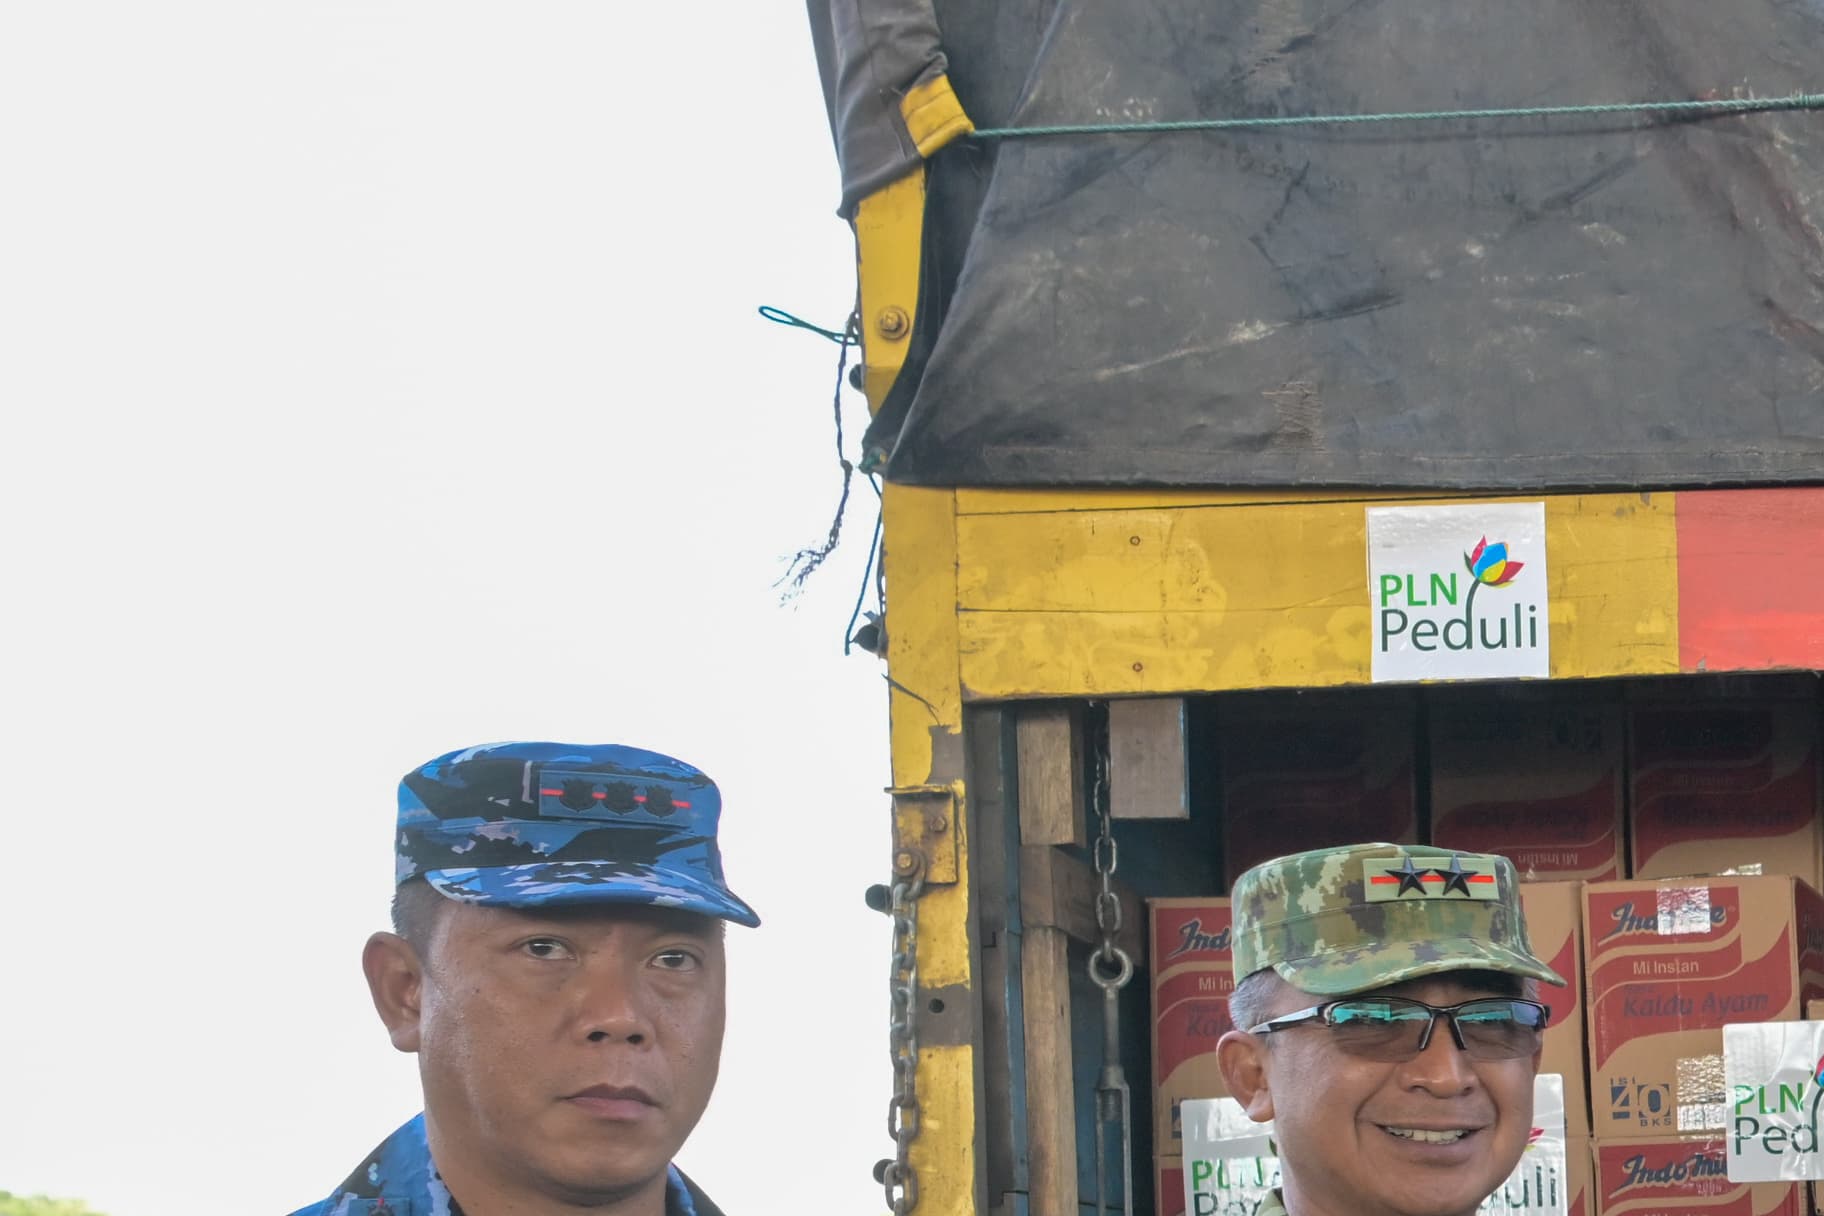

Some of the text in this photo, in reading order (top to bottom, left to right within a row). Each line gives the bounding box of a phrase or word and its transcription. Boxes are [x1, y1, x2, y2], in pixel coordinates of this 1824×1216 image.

[1380, 573, 1457, 607] PLN
[1380, 603, 1537, 652] Peduli
[1633, 960, 1699, 975] Mi Instan
[1198, 977, 1215, 990] Mi
[1623, 994, 1693, 1018] Kaldu
[1611, 1084, 1671, 1120] 40
[1734, 1082, 1803, 1115] PLN
[1640, 1118, 1671, 1127] BKS
